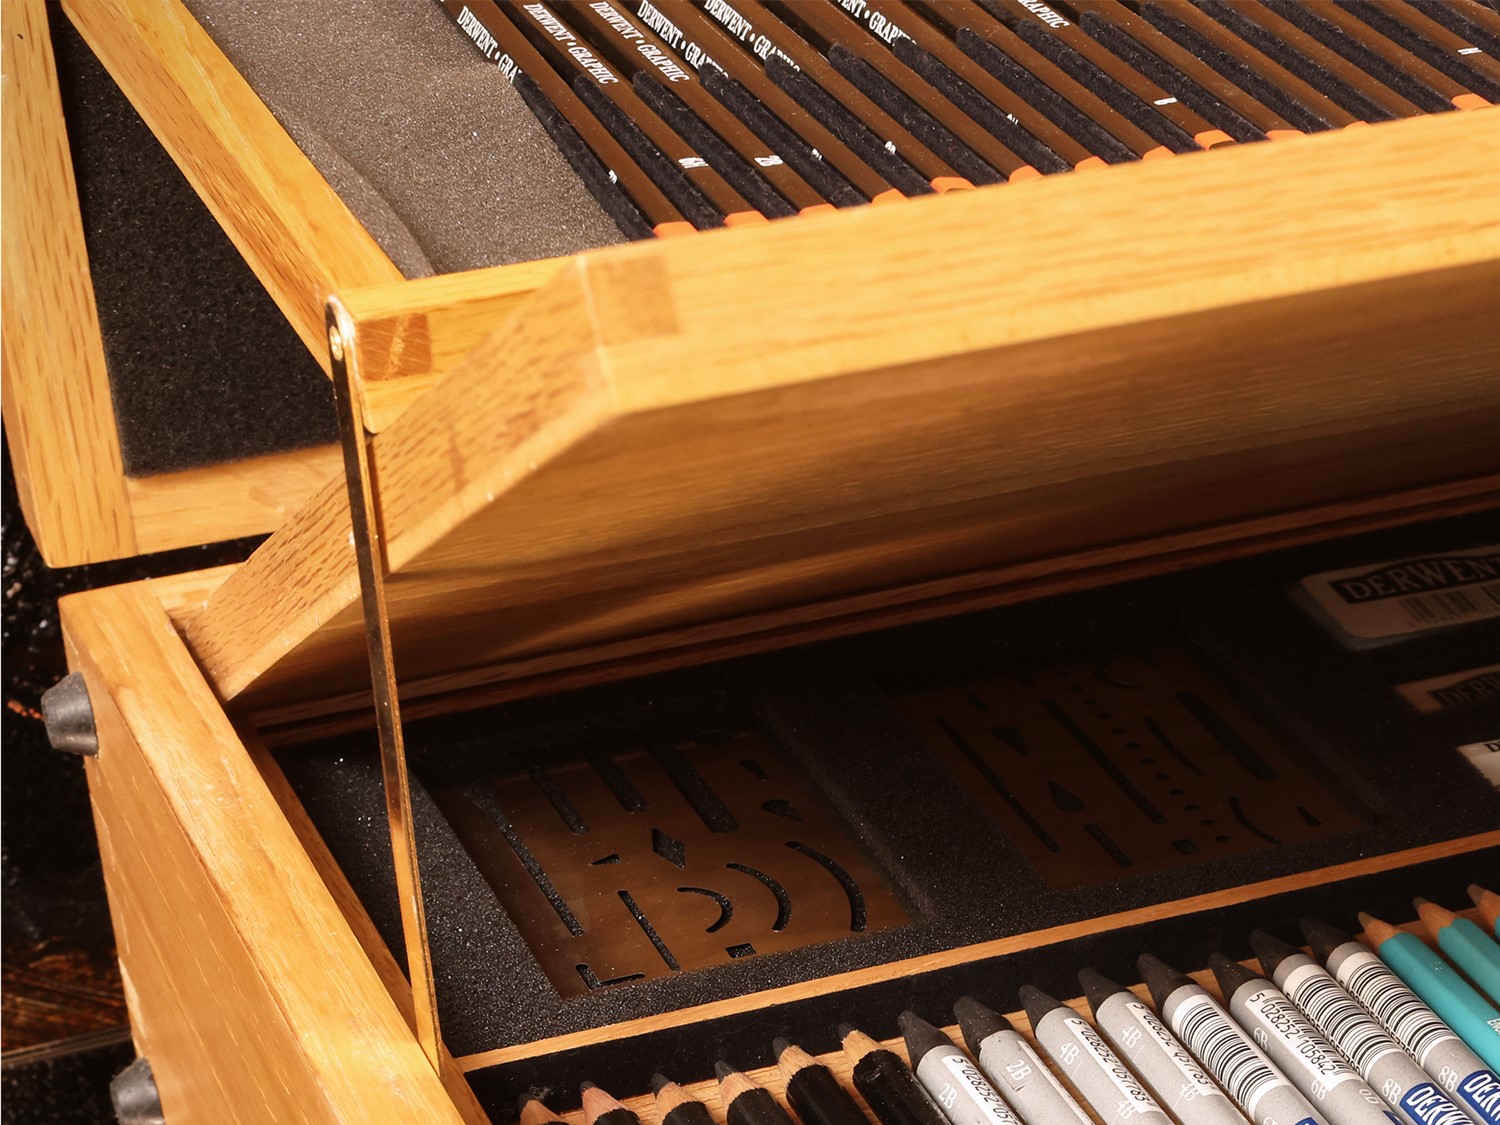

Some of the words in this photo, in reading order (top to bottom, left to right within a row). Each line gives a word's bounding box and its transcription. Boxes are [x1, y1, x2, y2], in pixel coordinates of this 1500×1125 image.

[456, 5, 498, 59] DERWENT
[523, 3, 577, 41] DERWENT
[568, 46, 619, 84] GRAPHIC
[589, 1, 643, 40] DERWENT
[637, 44, 690, 83] GRAPHIC
[637, 0, 683, 49] DERWENT
[704, 0, 753, 42] DERWENT
[1060, 1042, 1079, 1066] 4B
[1122, 1026, 1142, 1049] 4B
[1249, 992, 1264, 1003] 5
[1261, 1003, 1300, 1040] 028252
[1296, 1040, 1336, 1076] 105842
[1005, 1059, 1032, 1081] 2B
[1437, 1066, 1459, 1093] 8B
